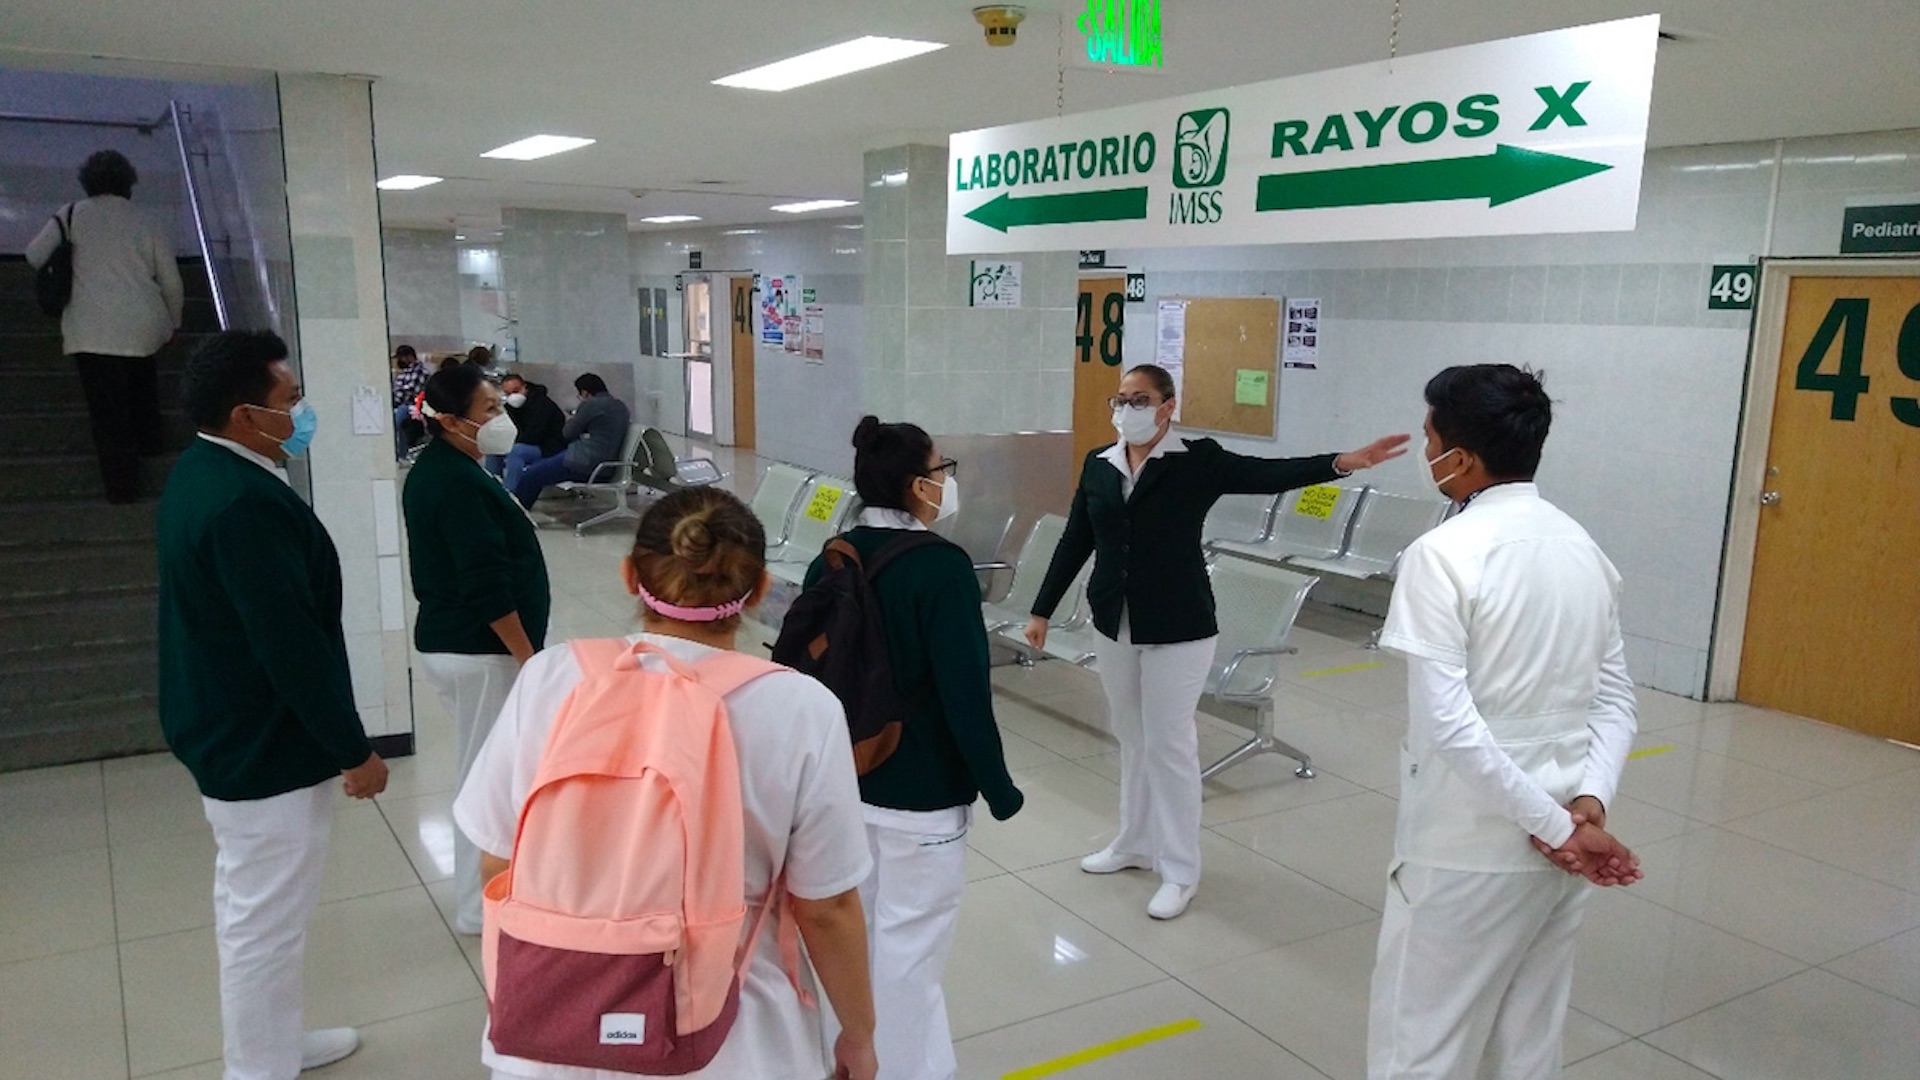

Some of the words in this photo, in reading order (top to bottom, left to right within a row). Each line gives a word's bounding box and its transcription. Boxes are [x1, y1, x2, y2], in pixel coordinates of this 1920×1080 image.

[1087, 0, 1163, 68] SALIDA
[1271, 93, 1500, 159] RAYOS
[1528, 80, 1592, 132] X
[956, 131, 1156, 192] LABORATORIO
[1168, 190, 1223, 225] IMSS
[1851, 220, 1920, 239] Pediatri
[1126, 277, 1145, 298] 48
[1710, 272, 1753, 303] 49
[734, 286, 753, 336] 4
[1075, 291, 1125, 367] 48
[606, 1030, 637, 1039] adidas
